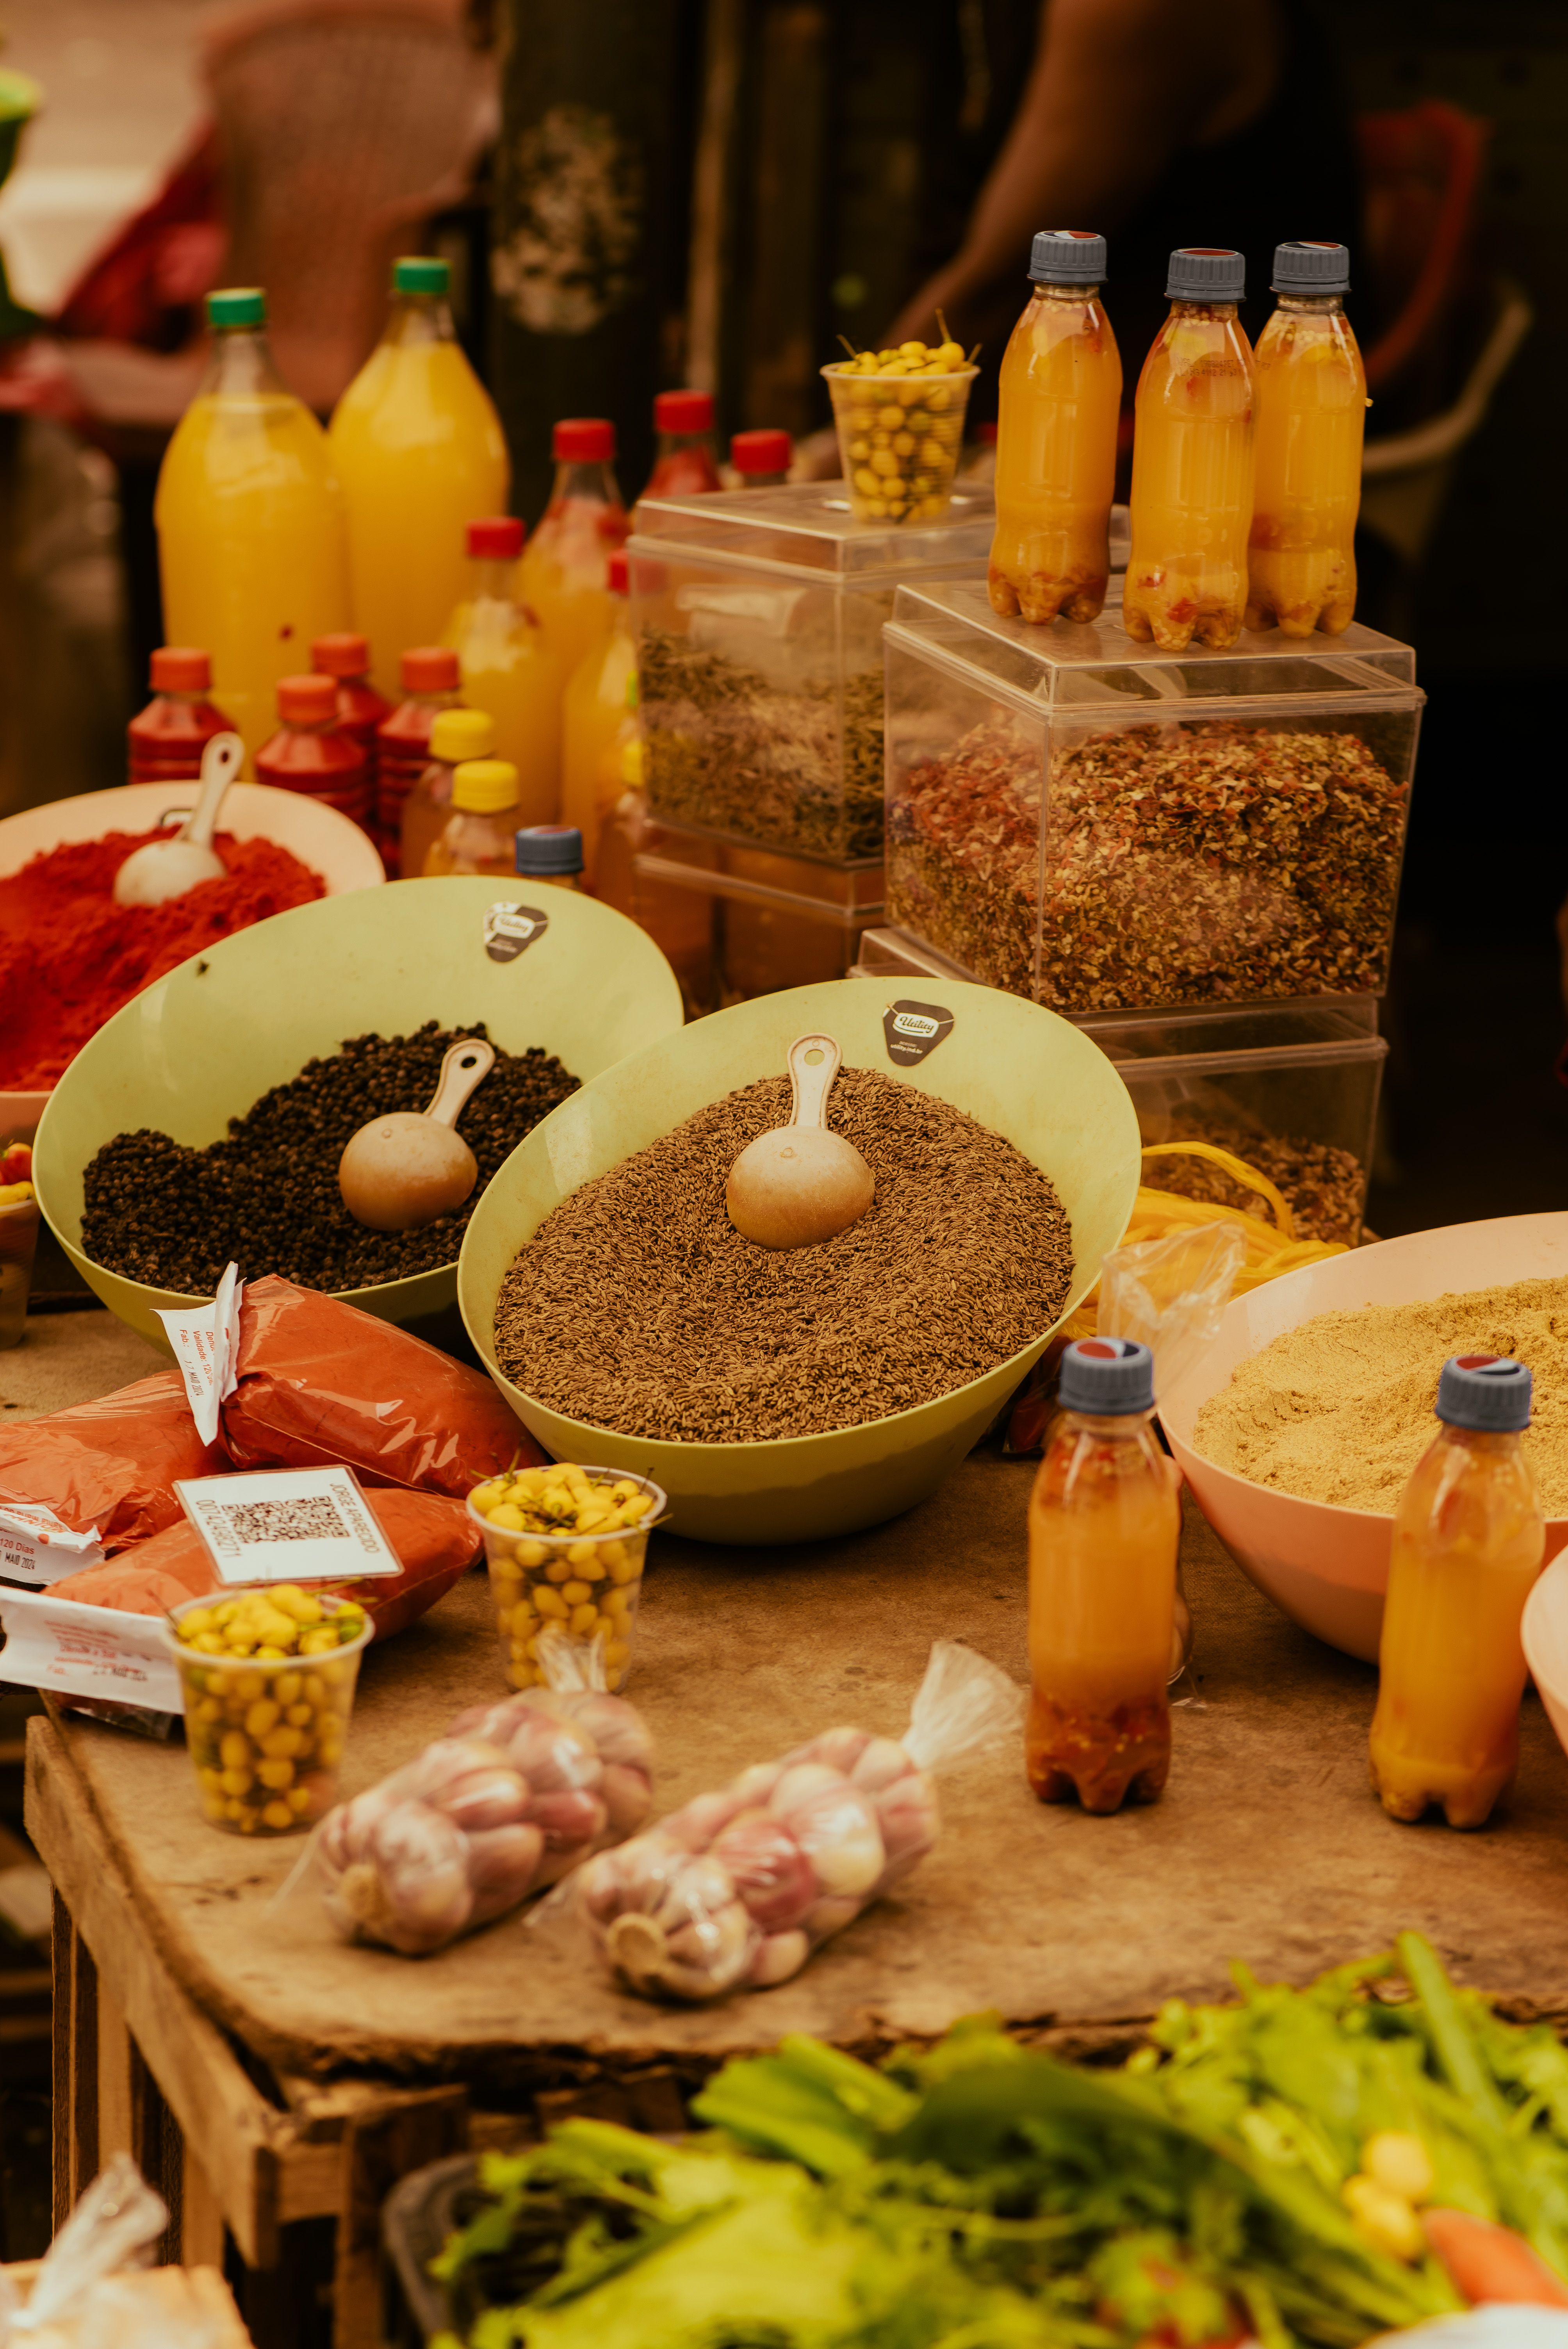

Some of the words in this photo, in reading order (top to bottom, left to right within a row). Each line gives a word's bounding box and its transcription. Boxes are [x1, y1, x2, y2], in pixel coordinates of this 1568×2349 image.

[900, 1016, 934, 1033] Utility
[179, 1329, 189, 1347] Fab.:
[193, 1330, 207, 1362] Validade:
[188, 1371, 200, 1383] MAIO
[191, 1385, 204, 1396] 2024
[330, 1483, 356, 1506] JORGE
[344, 1508, 381, 1553] APARECIDO
[16, 1542, 34, 1554] Dias
[4, 1552, 20, 1565] MAIO
[21, 1557, 36, 1569] 2024
